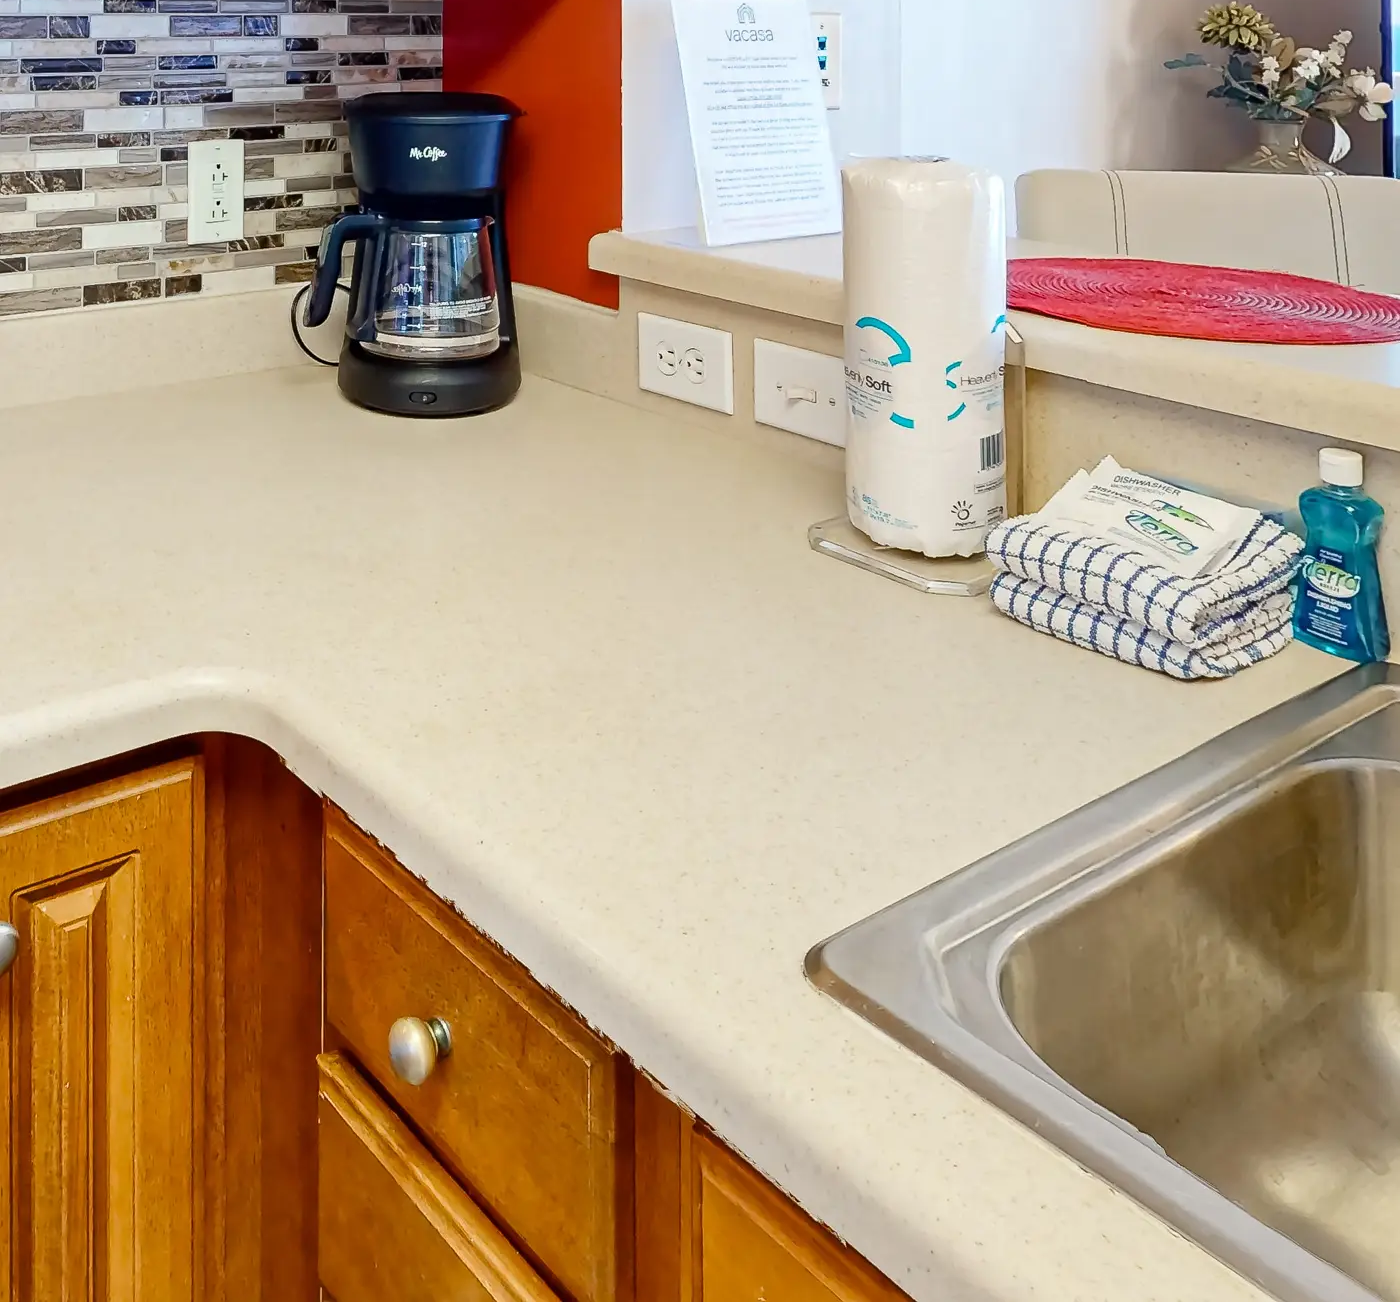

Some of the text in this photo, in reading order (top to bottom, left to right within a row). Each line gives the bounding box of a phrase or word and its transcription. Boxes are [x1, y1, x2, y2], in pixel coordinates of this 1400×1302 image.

[725, 29, 774, 42] vacasa
[865, 375, 893, 394] Soft
[1113, 475, 1182, 497] DISHWASHER
